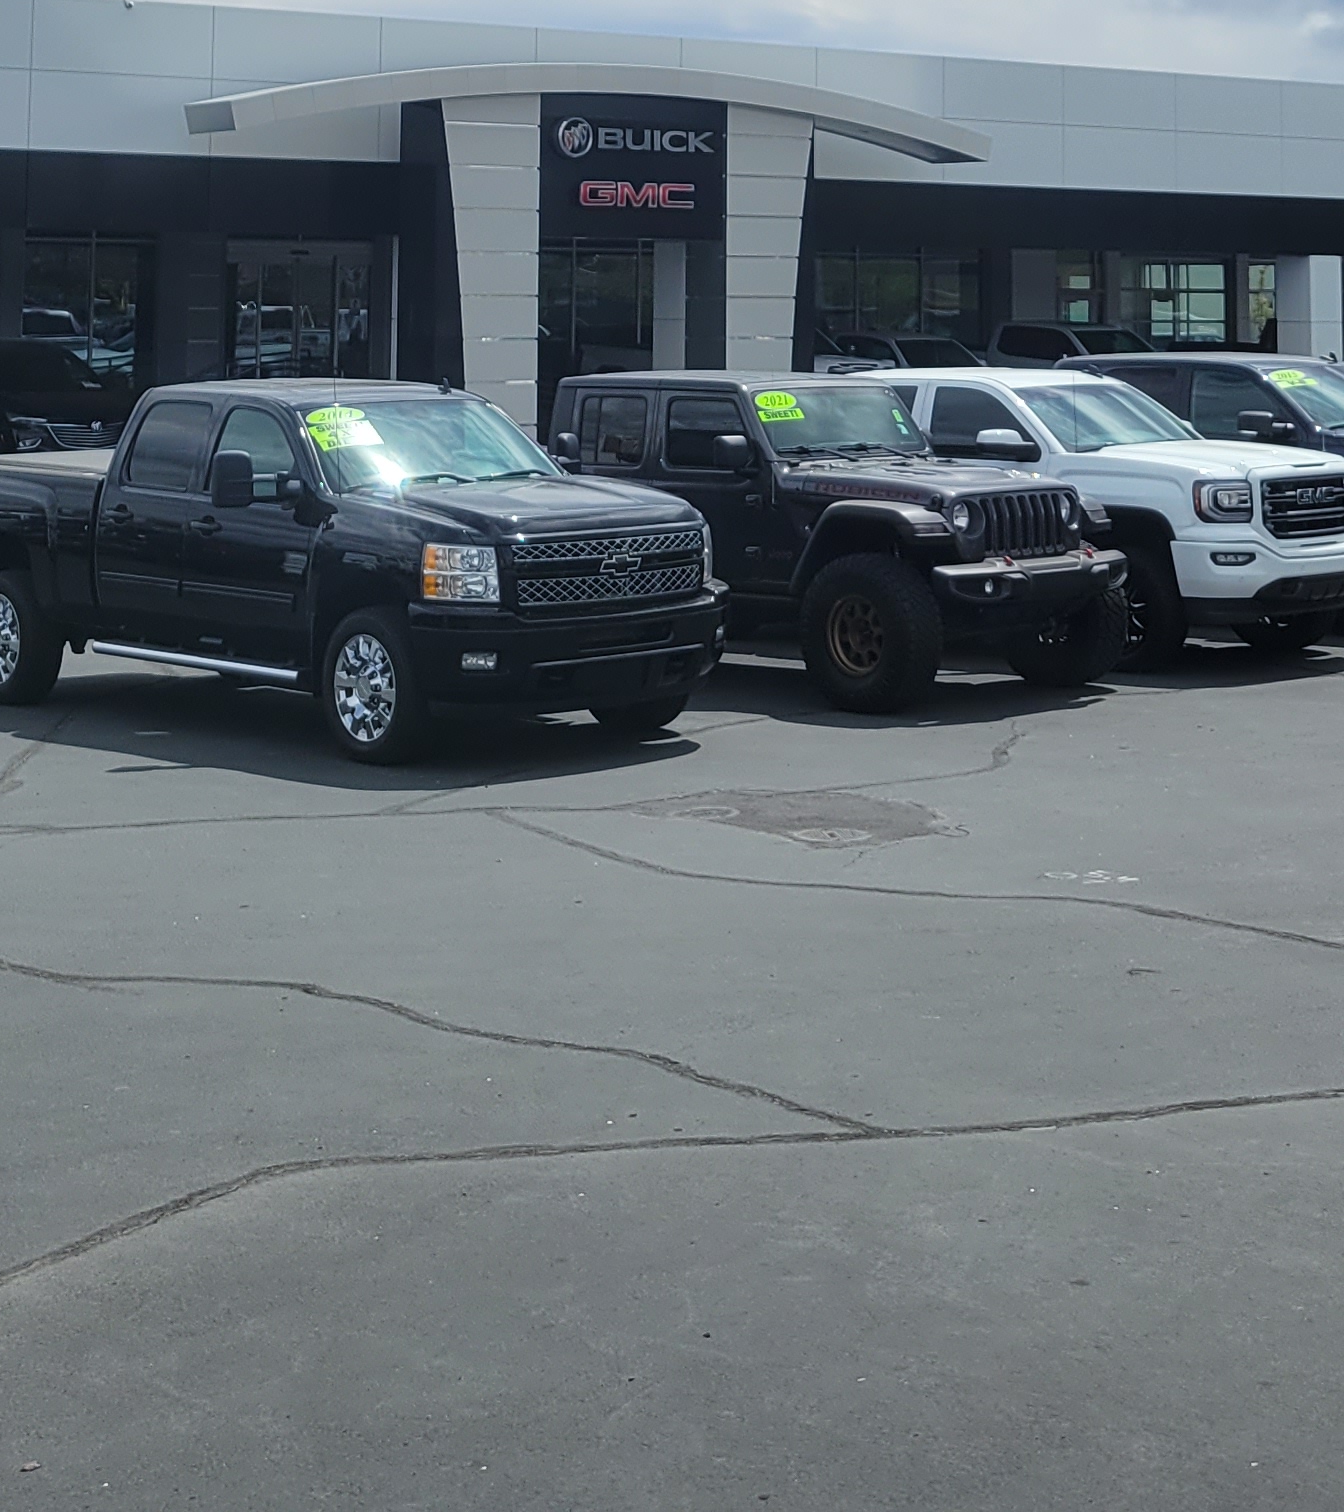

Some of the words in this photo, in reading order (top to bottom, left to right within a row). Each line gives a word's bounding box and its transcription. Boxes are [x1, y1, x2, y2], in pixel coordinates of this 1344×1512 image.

[597, 126, 715, 154] BUICK
[580, 180, 695, 209] GMC
[764, 394, 789, 407] 2021
[1297, 486, 1335, 505] GMC
